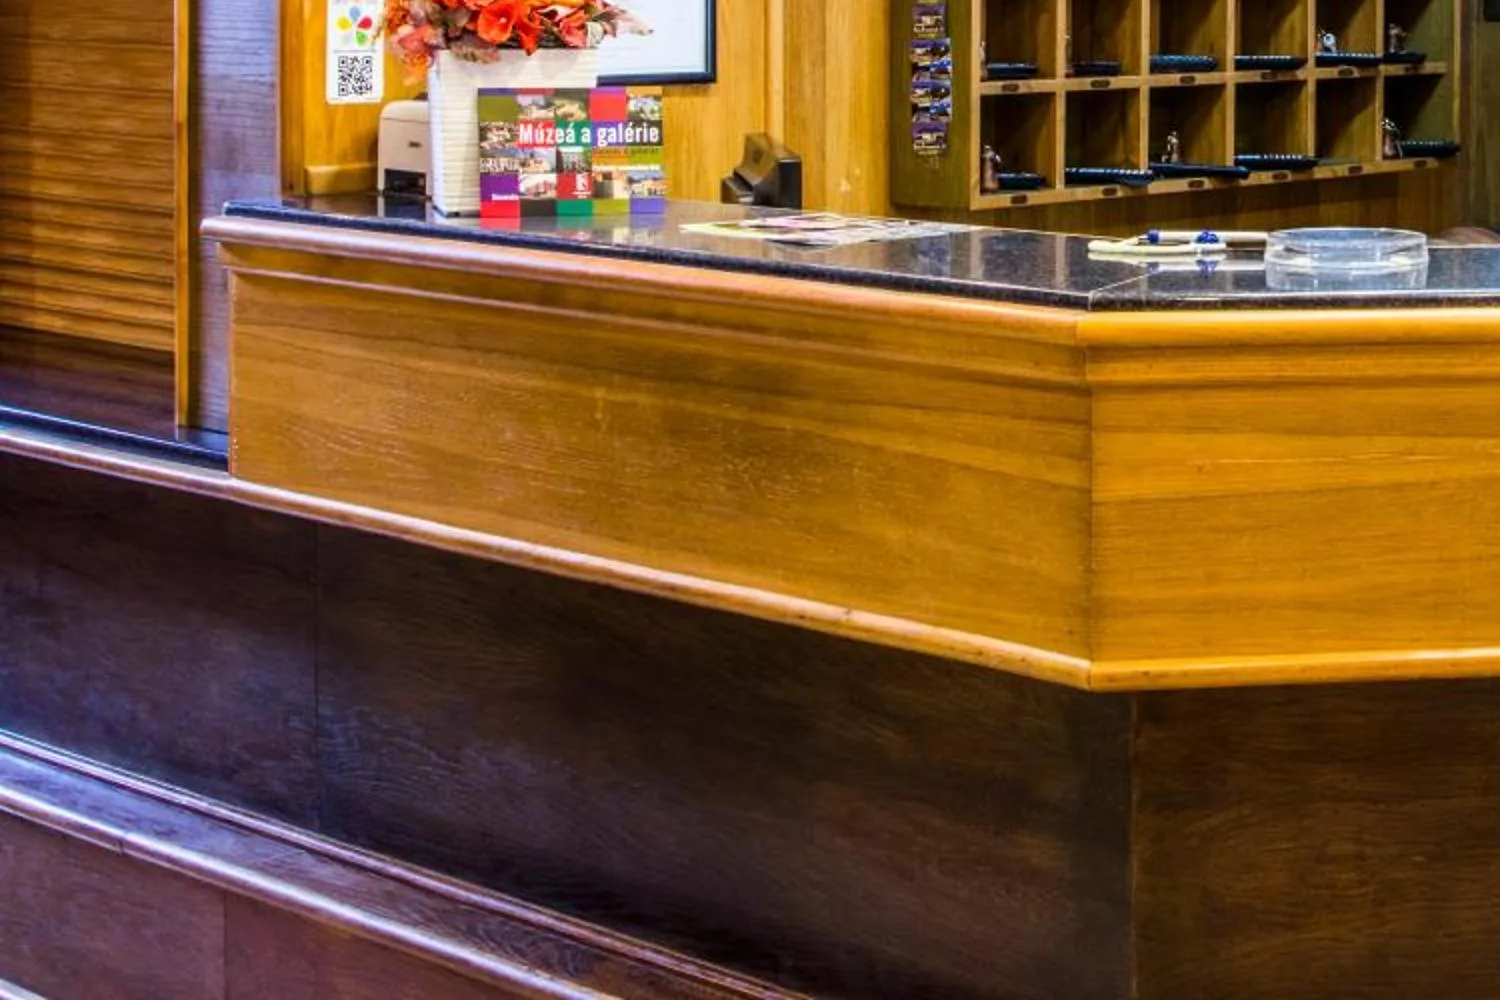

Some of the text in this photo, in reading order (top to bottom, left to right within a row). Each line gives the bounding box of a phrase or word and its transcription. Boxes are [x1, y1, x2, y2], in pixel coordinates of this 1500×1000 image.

[518, 121, 660, 147] Múzeá a galérie
